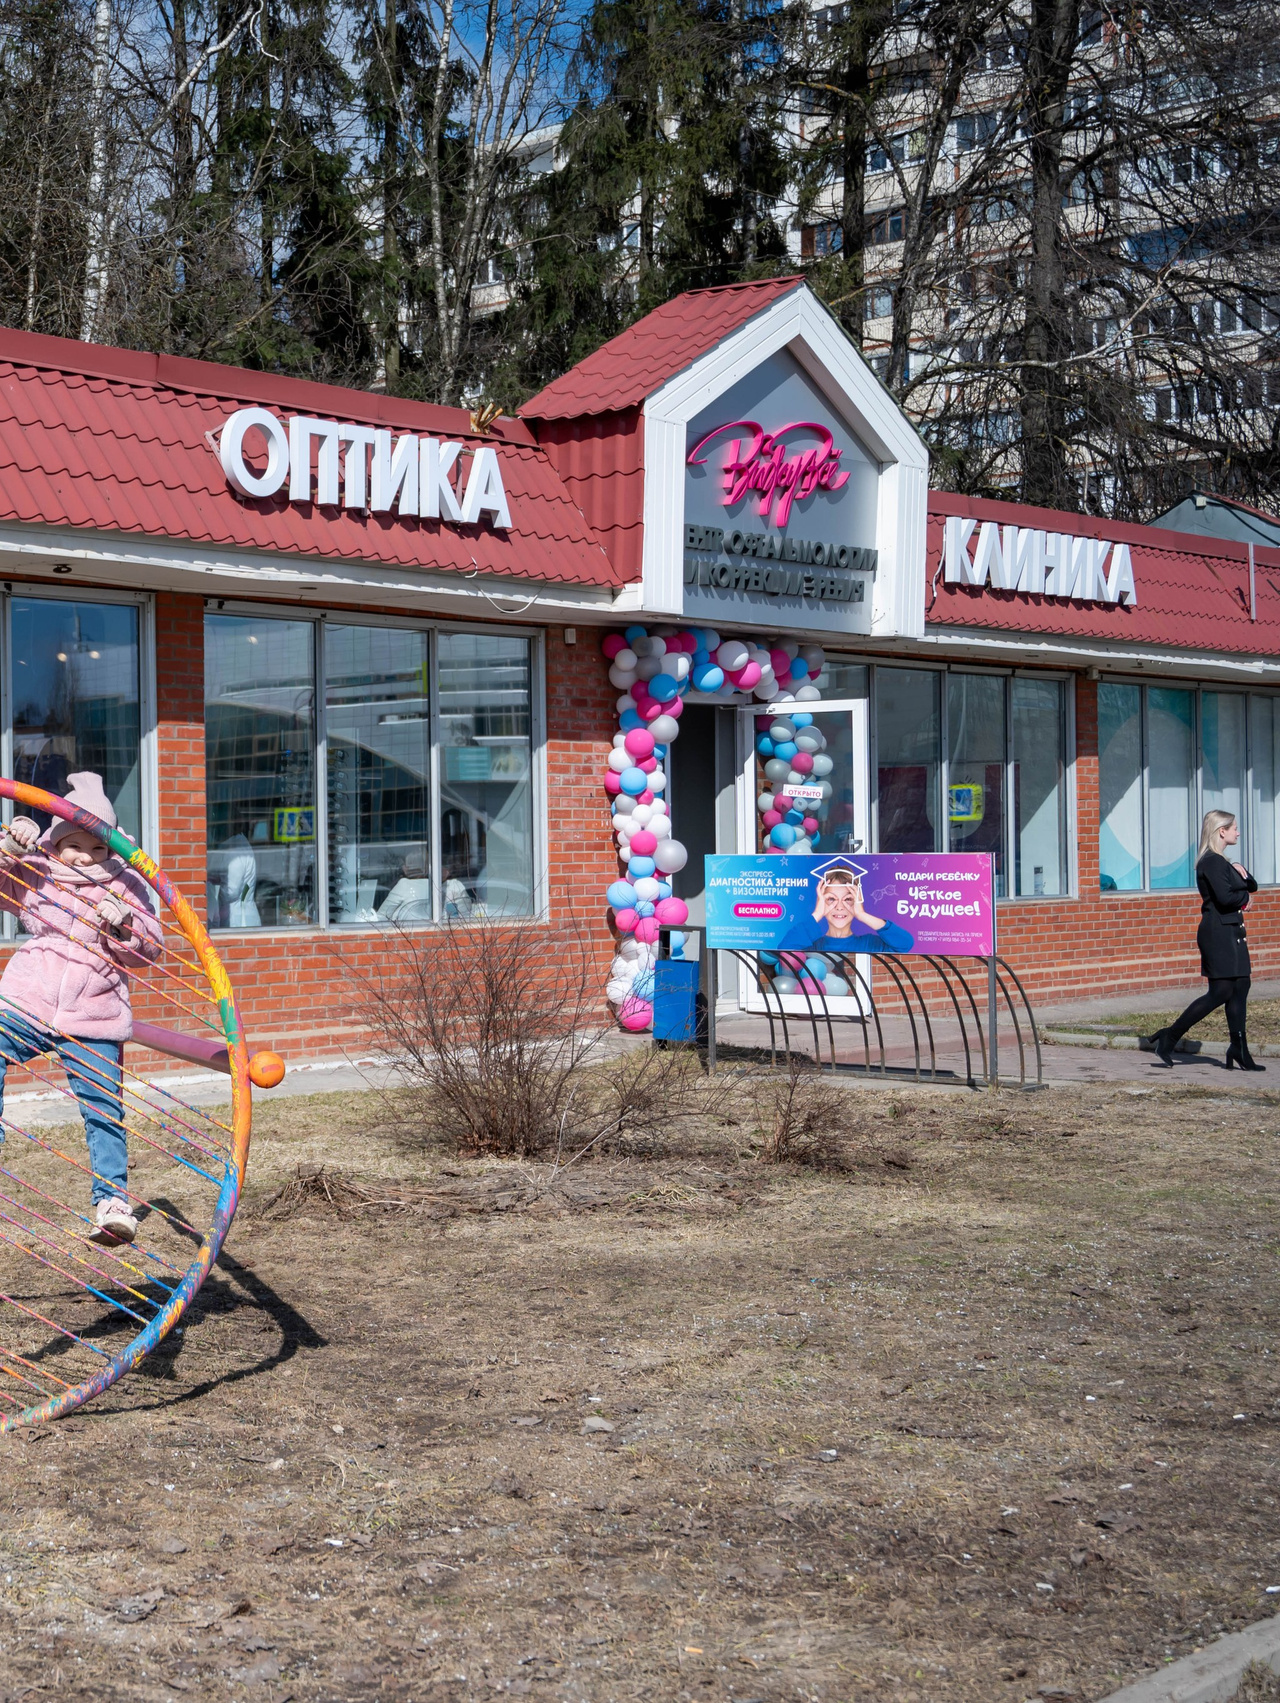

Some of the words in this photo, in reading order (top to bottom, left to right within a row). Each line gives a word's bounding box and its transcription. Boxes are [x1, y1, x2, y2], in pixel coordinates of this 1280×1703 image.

[221, 407, 513, 529] ОПТИКА
[684, 524, 724, 551] ЕНТР
[725, 530, 878, 571] ОФТАЛЬМОЛОГИИ
[945, 516, 1138, 606] КЛИНИКА
[788, 789, 821, 797] ОТКРЫТО
[740, 870, 775, 878] ЭКСПРЕСС-
[895, 872, 934, 882] ПОДАРИ
[936, 871, 980, 881] РЕБЁНКУ
[710, 878, 773, 887] ДИАГНОСТИКА
[775, 878, 809, 887] ЗРЕНИЯ
[732, 887, 789, 896] ВИЗОМЕТРИЯ
[738, 907, 778, 915] БЕСПЛАТНО!
[897, 900, 981, 919] Будущее!
